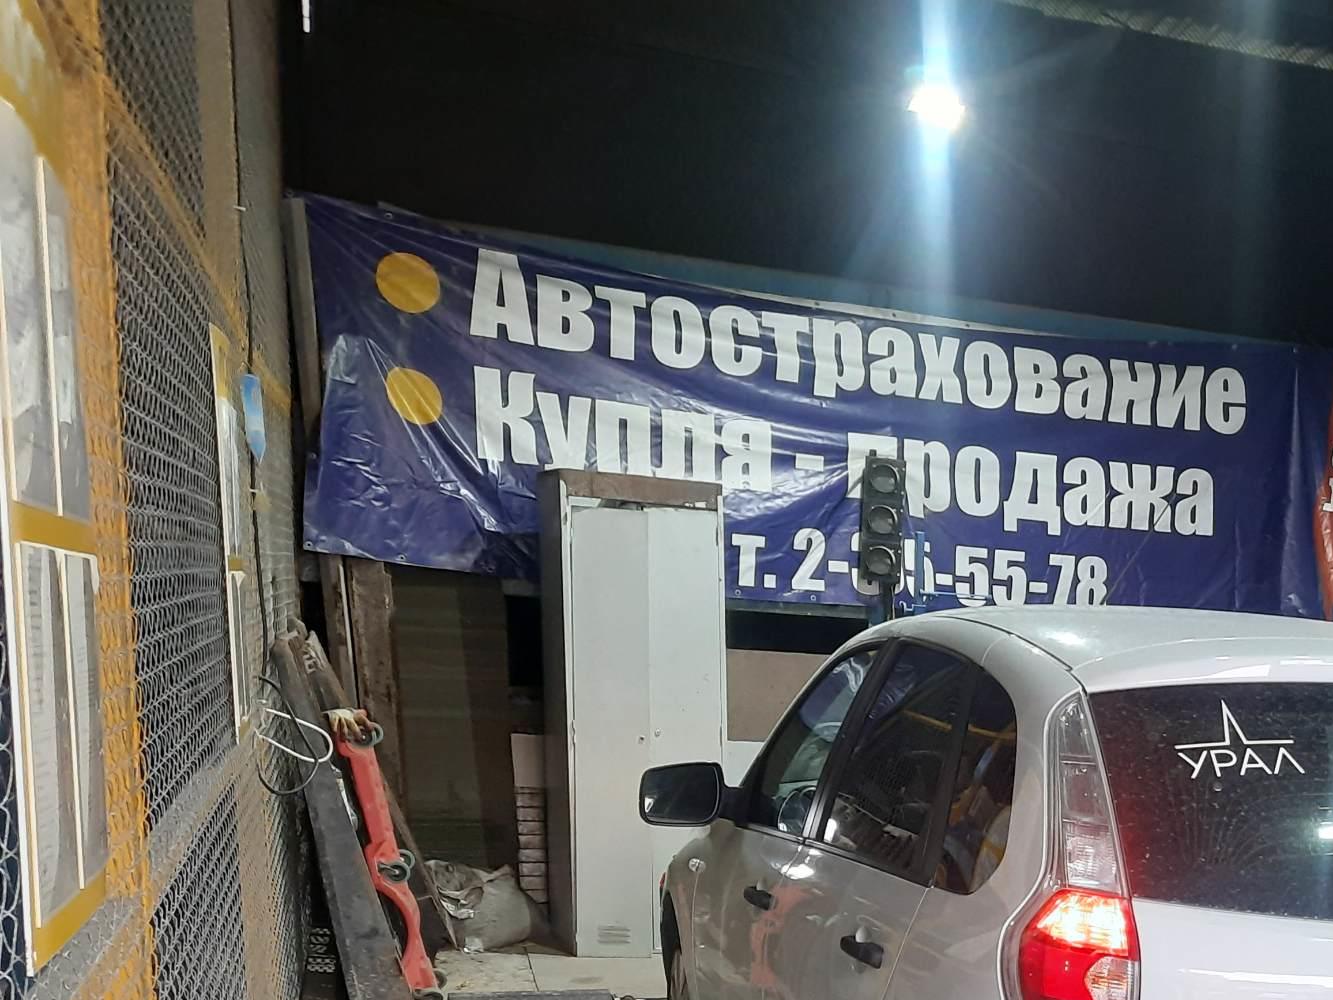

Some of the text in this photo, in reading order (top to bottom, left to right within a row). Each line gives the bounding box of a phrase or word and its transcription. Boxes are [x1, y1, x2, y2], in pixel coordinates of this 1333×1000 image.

[469, 248, 1247, 435] Автострахование
[474, 366, 773, 492] Купля
[848, 432, 1214, 536] продажа
[1177, 746, 1306, 779] УРАЛ
